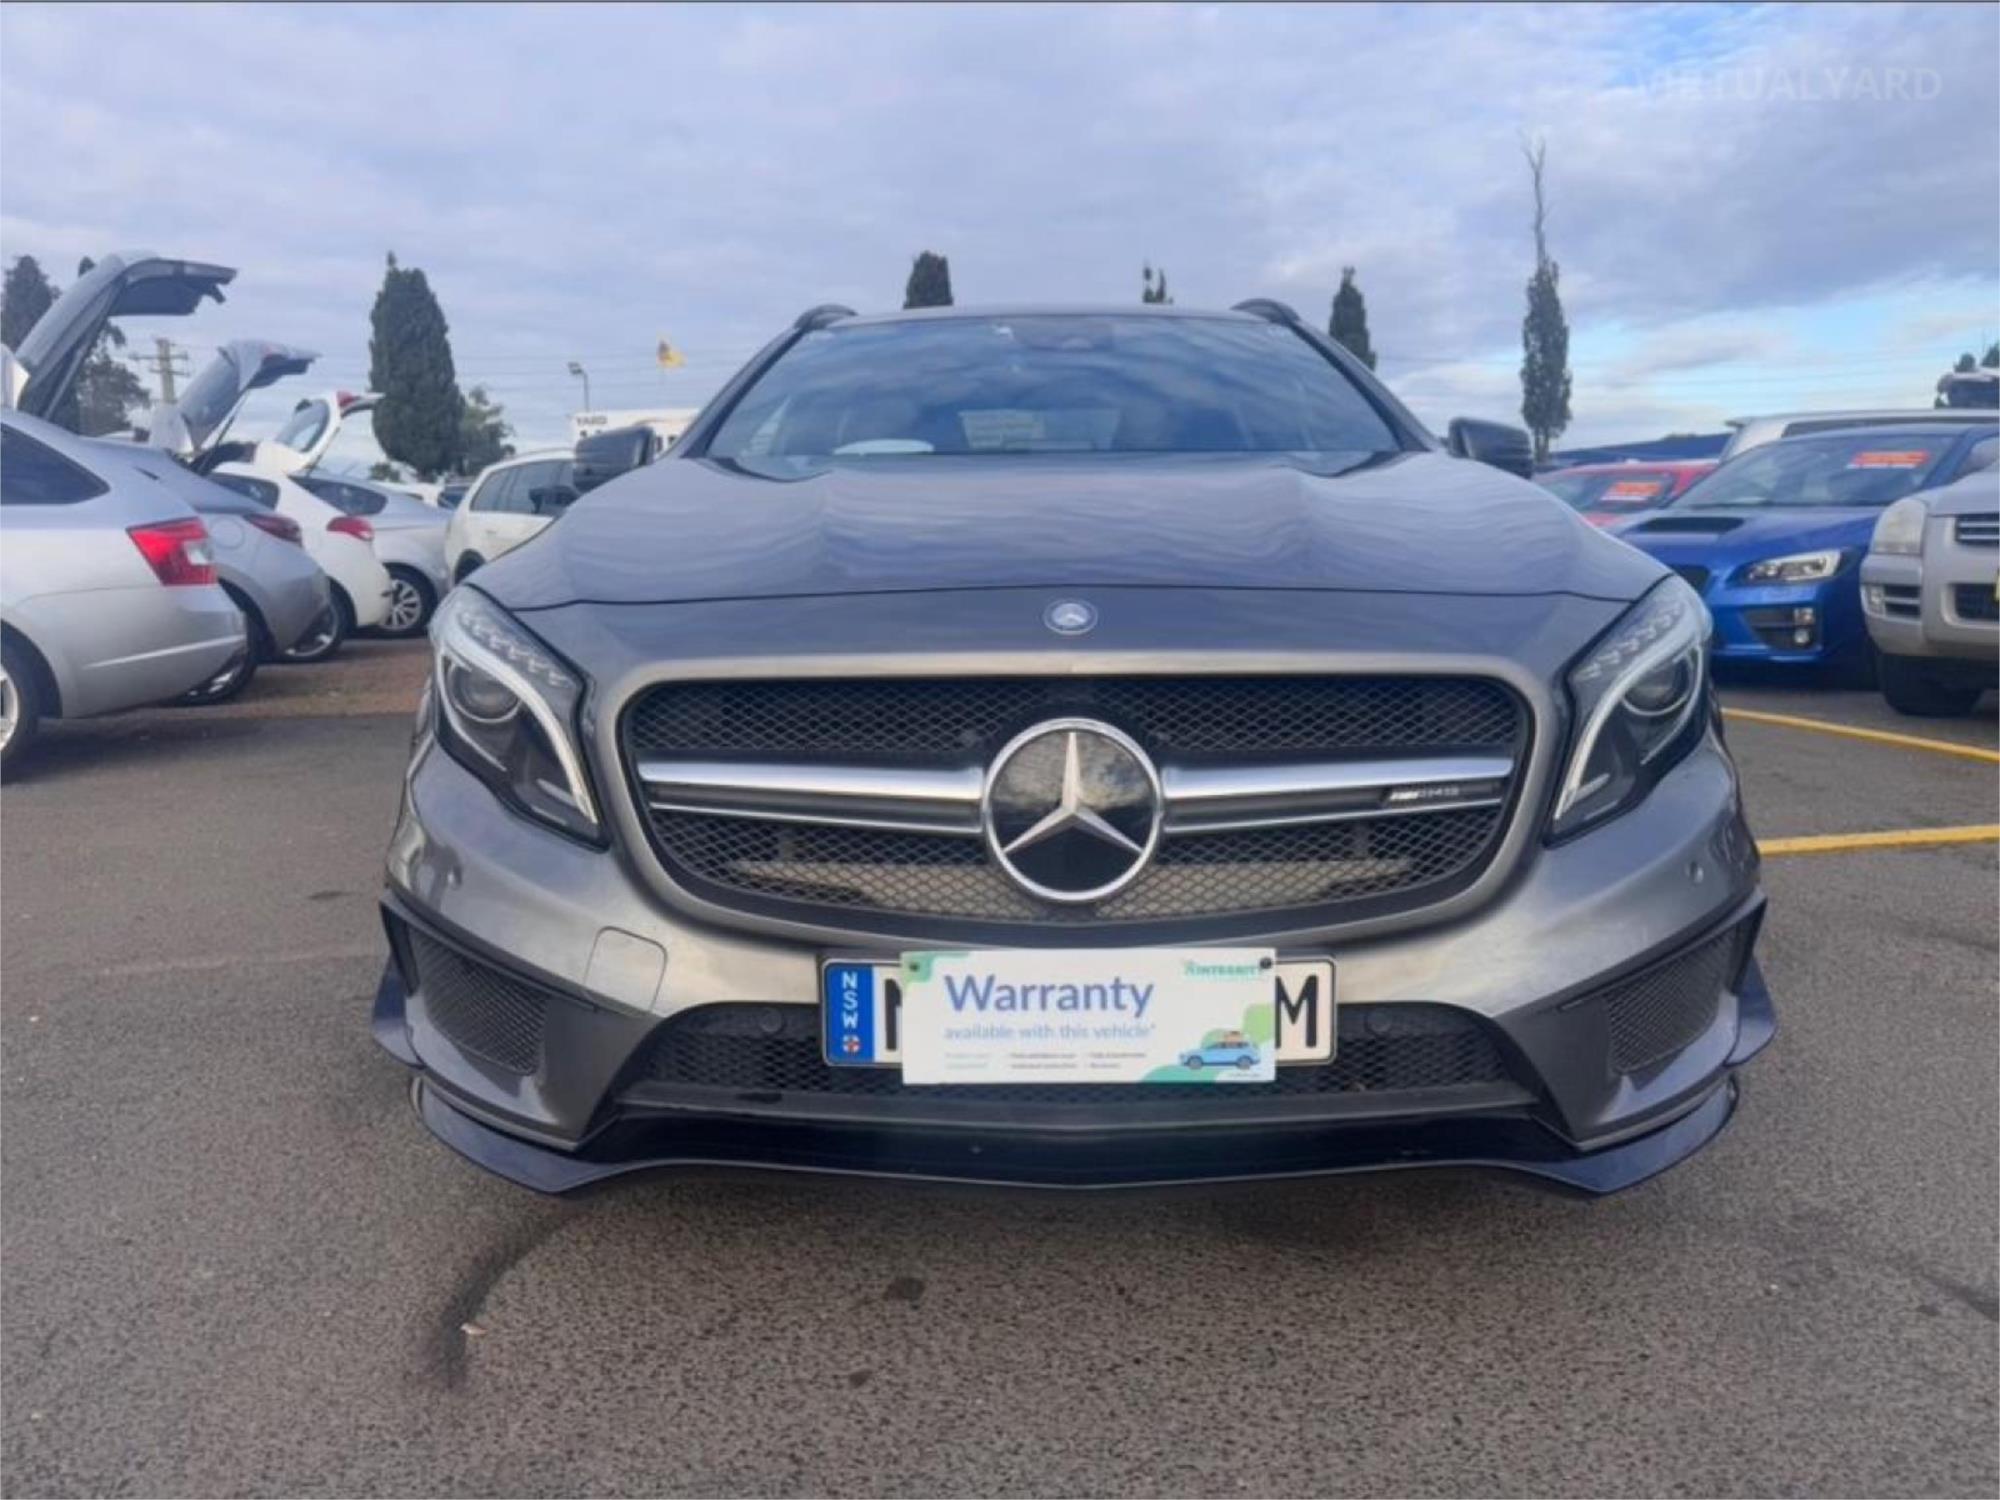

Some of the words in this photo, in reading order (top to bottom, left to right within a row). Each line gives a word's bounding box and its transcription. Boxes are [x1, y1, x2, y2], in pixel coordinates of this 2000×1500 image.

[842, 971, 859, 1029] NSW
[944, 974, 1154, 1018] Warranty
[944, 1024, 1013, 1039] available
[1019, 1024, 1054, 1039] with
[1059, 1024, 1089, 1039] this
